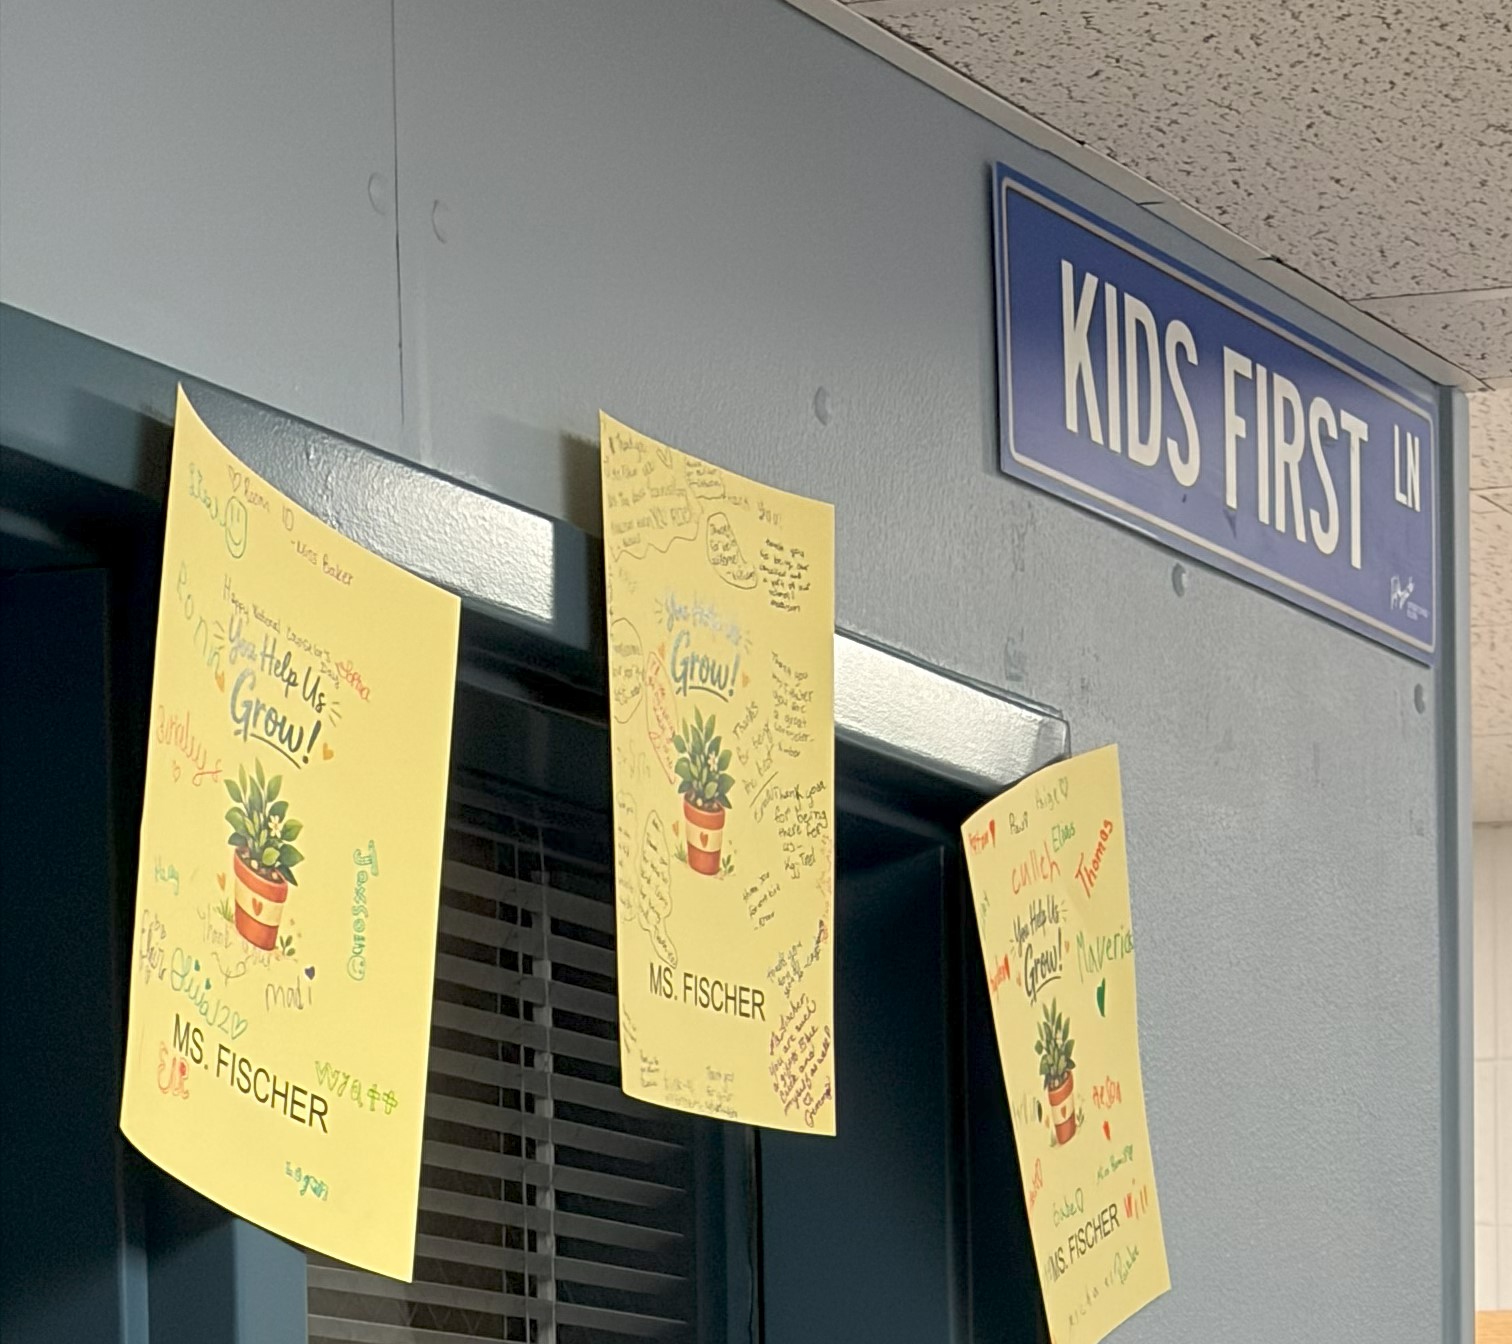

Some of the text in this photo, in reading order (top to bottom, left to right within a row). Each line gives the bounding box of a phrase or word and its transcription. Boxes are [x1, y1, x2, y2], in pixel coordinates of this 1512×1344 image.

[1060, 259, 1421, 570] KIDS FIRST LN
[228, 614, 327, 713] You Help Us
[671, 630, 740, 697] Grow!
[230, 668, 322, 764] Grow!
[1074, 819, 1113, 899] Thomas
[1013, 895, 1060, 958] You Help Us
[649, 962, 766, 1021] MS. FISCHER
[1024, 927, 1063, 1007] Grow!
[173, 1013, 328, 1133] MS. FISCHER
[1049, 1247, 1068, 1282] MS.
[1068, 1203, 1120, 1264] FISCHER
